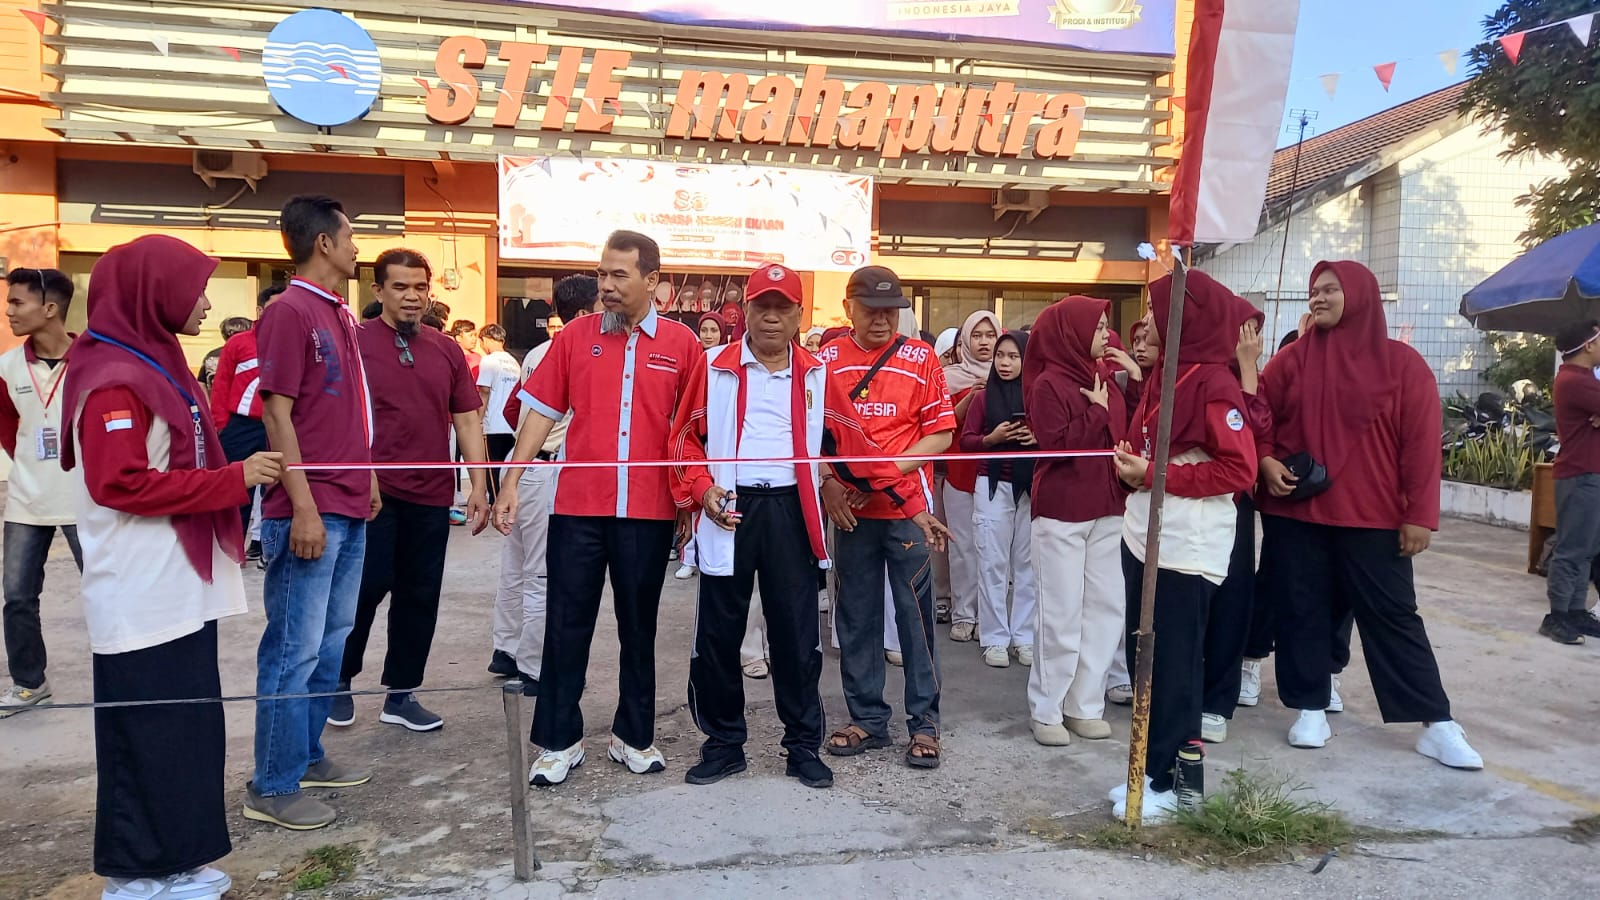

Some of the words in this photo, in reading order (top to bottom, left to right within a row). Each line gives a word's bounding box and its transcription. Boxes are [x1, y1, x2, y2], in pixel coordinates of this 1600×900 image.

[898, 5, 971, 15] INDONESIA
[979, 3, 1010, 13] JAYA
[425, 36, 632, 131] STIE
[665, 64, 1087, 159] mahaputra
[896, 344, 929, 362] 1945
